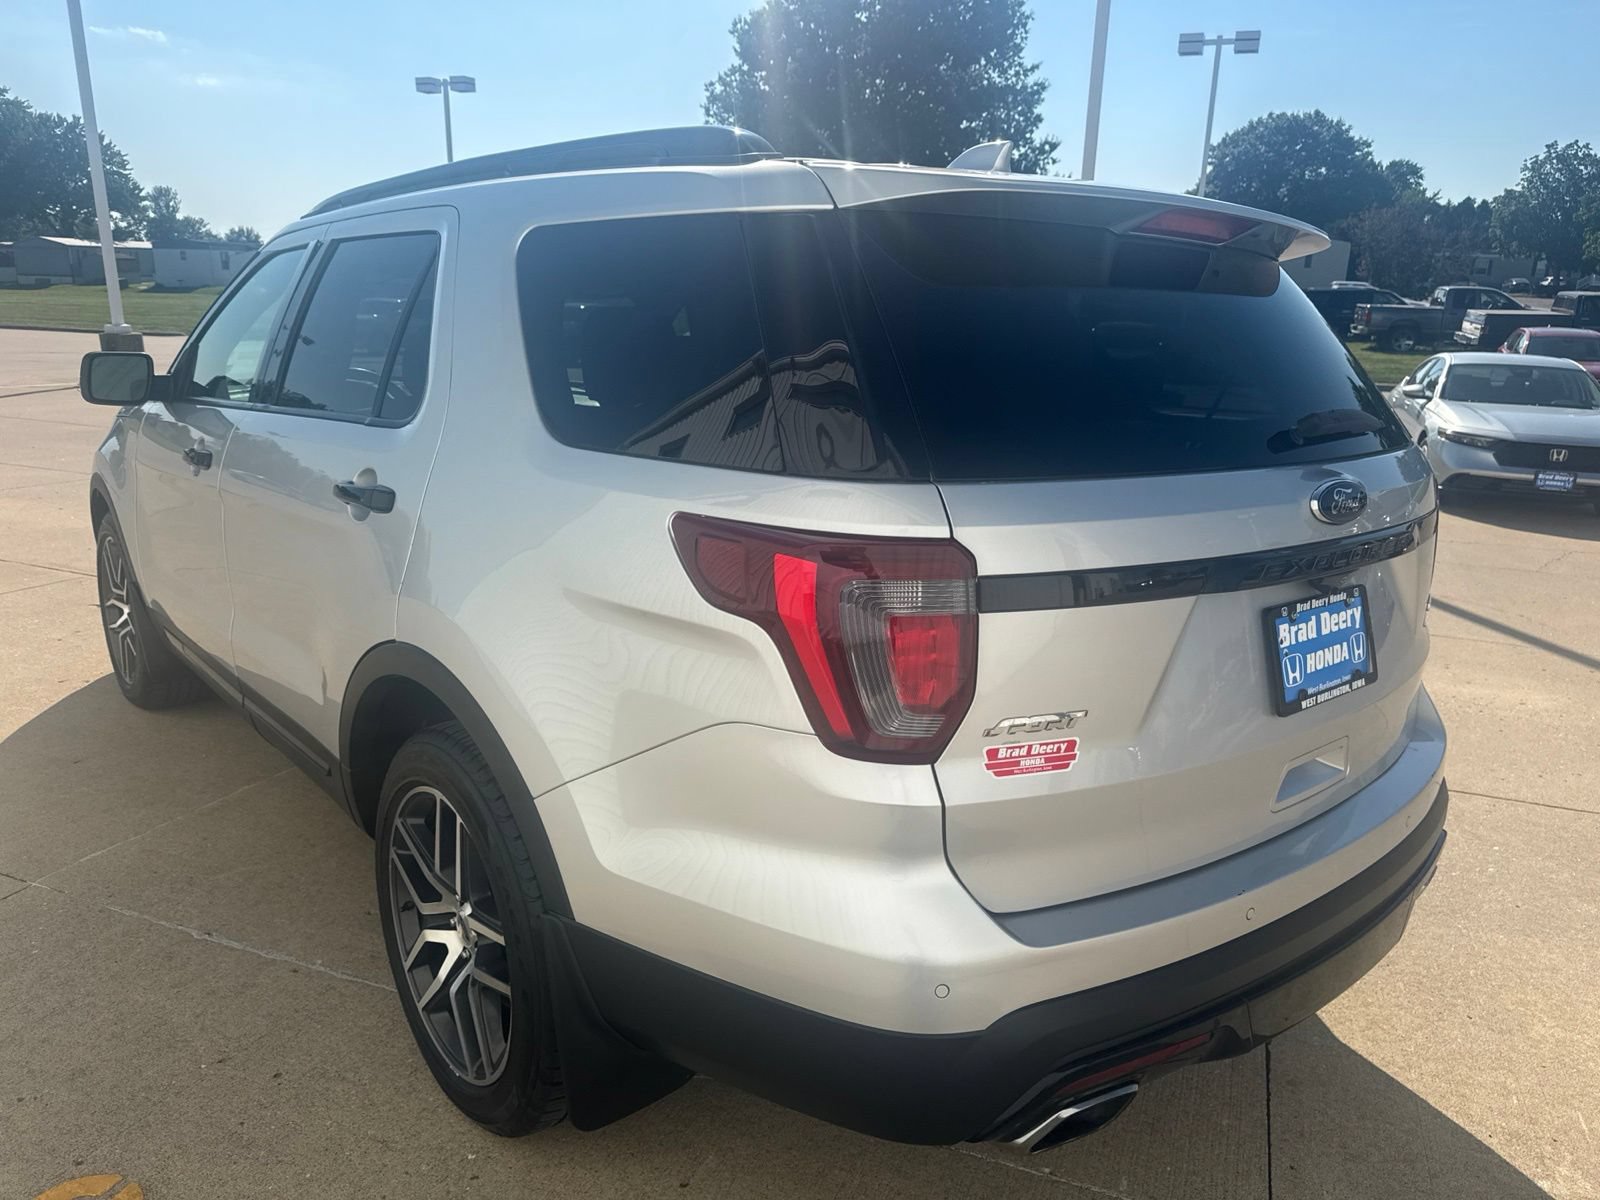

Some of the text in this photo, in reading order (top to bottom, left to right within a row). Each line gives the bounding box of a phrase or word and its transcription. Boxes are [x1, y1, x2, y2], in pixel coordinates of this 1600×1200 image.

[1331, 488, 1360, 514] Ford
[1258, 532, 1414, 582] EXPLORER
[1296, 592, 1346, 612] Brad Deery Honda
[1279, 606, 1362, 648] Brad Deery
[1306, 641, 1350, 673] HONDA
[1301, 696, 1316, 709] WEST
[1352, 677, 1366, 690] IOWA
[982, 709, 1088, 737] SPORT
[997, 742, 1068, 759] Brad Deery
[1020, 757, 1045, 767] HONDA
